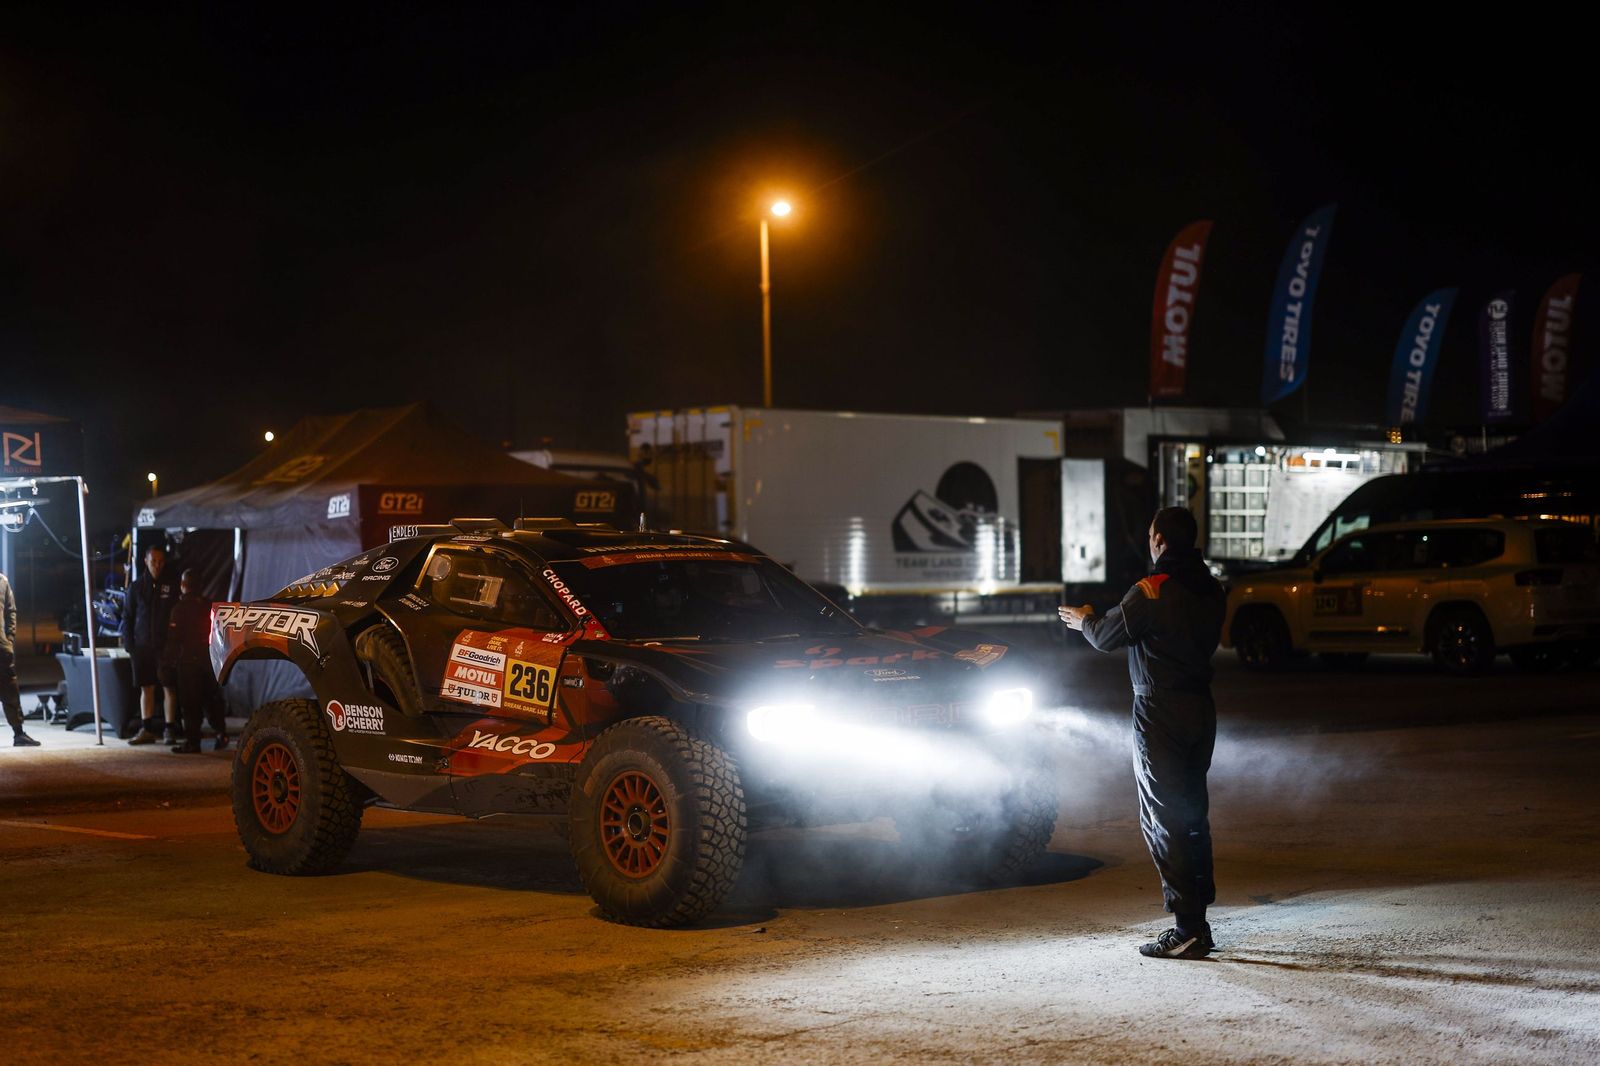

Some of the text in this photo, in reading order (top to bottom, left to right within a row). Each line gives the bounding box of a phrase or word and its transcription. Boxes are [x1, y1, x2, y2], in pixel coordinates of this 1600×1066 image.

[1162, 243, 1202, 368] MOTUL
[1280, 302, 1303, 383] TIRES
[1409, 303, 1442, 368] TOYO
[1540, 296, 1573, 402] MOTUL
[328, 494, 351, 514] GT2i
[380, 492, 424, 511] GT2i
[575, 491, 616, 508] GT2i
[392, 526, 419, 538] ENDLESS
[896, 558, 928, 568] TEAM
[543, 569, 587, 616] CHOPARD
[215, 606, 320, 659] RAPTOR
[458, 648, 501, 665] BFGoodrich
[774, 650, 941, 669] spark
[454, 666, 497, 686] MOTUL
[510, 663, 550, 702] 236
[457, 686, 490, 701] TUDOR
[345, 704, 384, 719] BENSON
[346, 717, 385, 731] CHERRY
[467, 730, 556, 759] YACCO
[395, 754, 408, 763] KING
